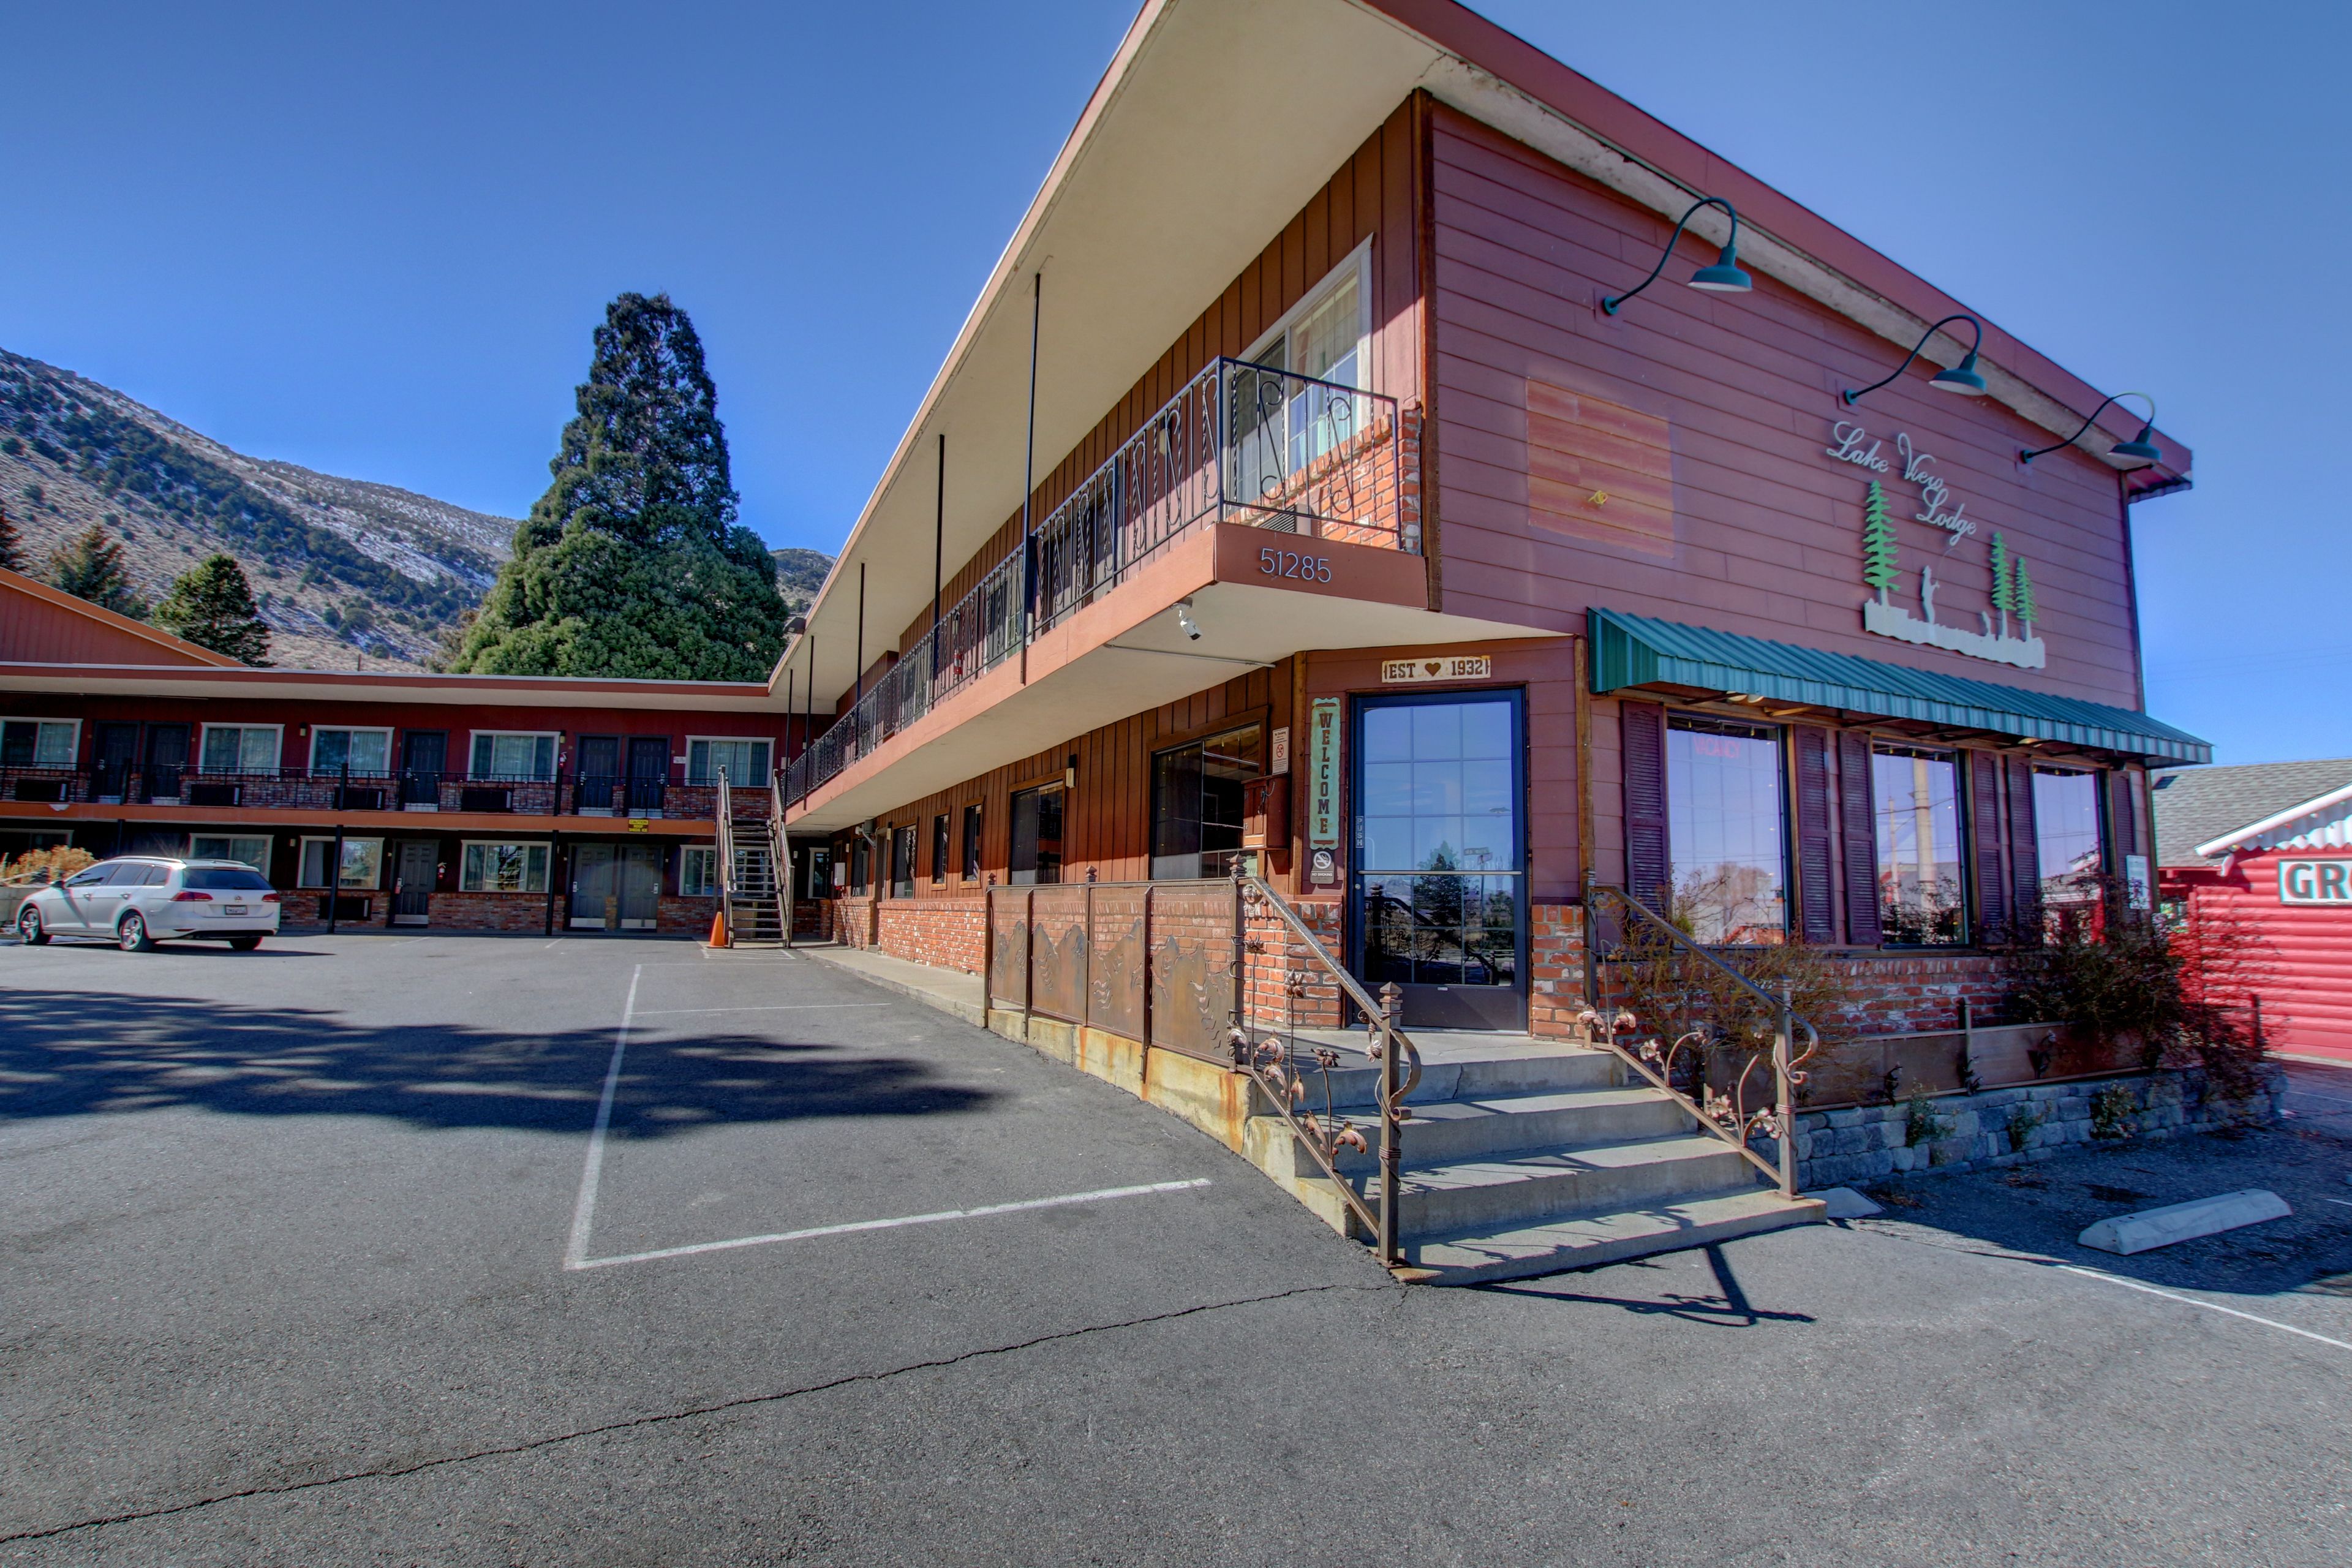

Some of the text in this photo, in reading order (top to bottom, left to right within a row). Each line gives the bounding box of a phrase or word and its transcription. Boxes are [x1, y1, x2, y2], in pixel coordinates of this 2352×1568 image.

[1826, 421, 1944, 491] Lake View
[1915, 488, 1977, 546] Lodge
[1261, 548, 1332, 583] 51285
[1389, 659, 1483, 679] EST 1932
[1693, 736, 1741, 759] VACANCY
[1317, 713, 1333, 834] WELCOME
[2286, 862, 2352, 899] GR
